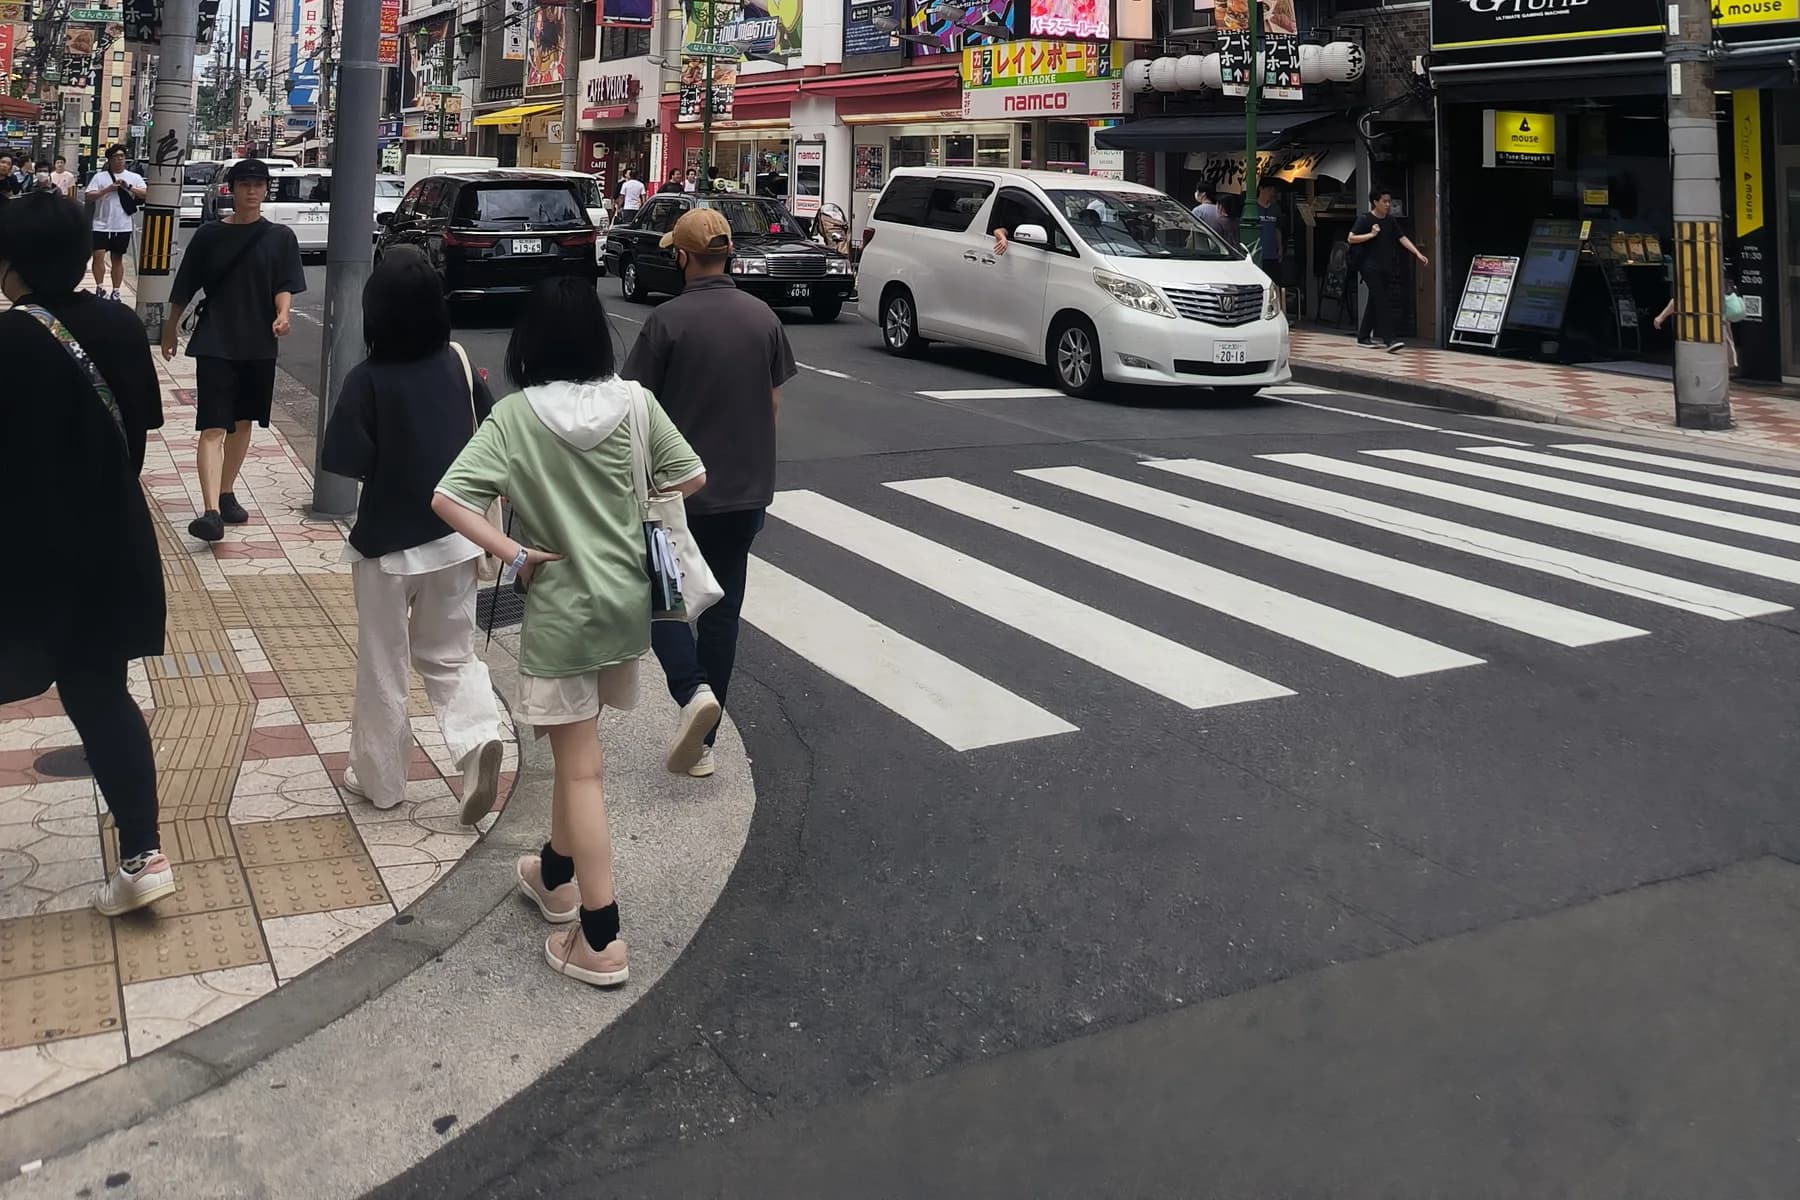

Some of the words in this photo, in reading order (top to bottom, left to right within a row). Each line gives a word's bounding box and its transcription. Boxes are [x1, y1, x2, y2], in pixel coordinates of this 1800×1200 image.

[1728, 0, 1783, 16] mouse
[1265, 40, 1296, 56] フード
[996, 42, 1082, 75] レインボー
[1266, 57, 1300, 72] ホール
[1017, 74, 1056, 86] KARAOKE
[1004, 92, 1067, 112] namco
[1511, 133, 1540, 144] mouse
